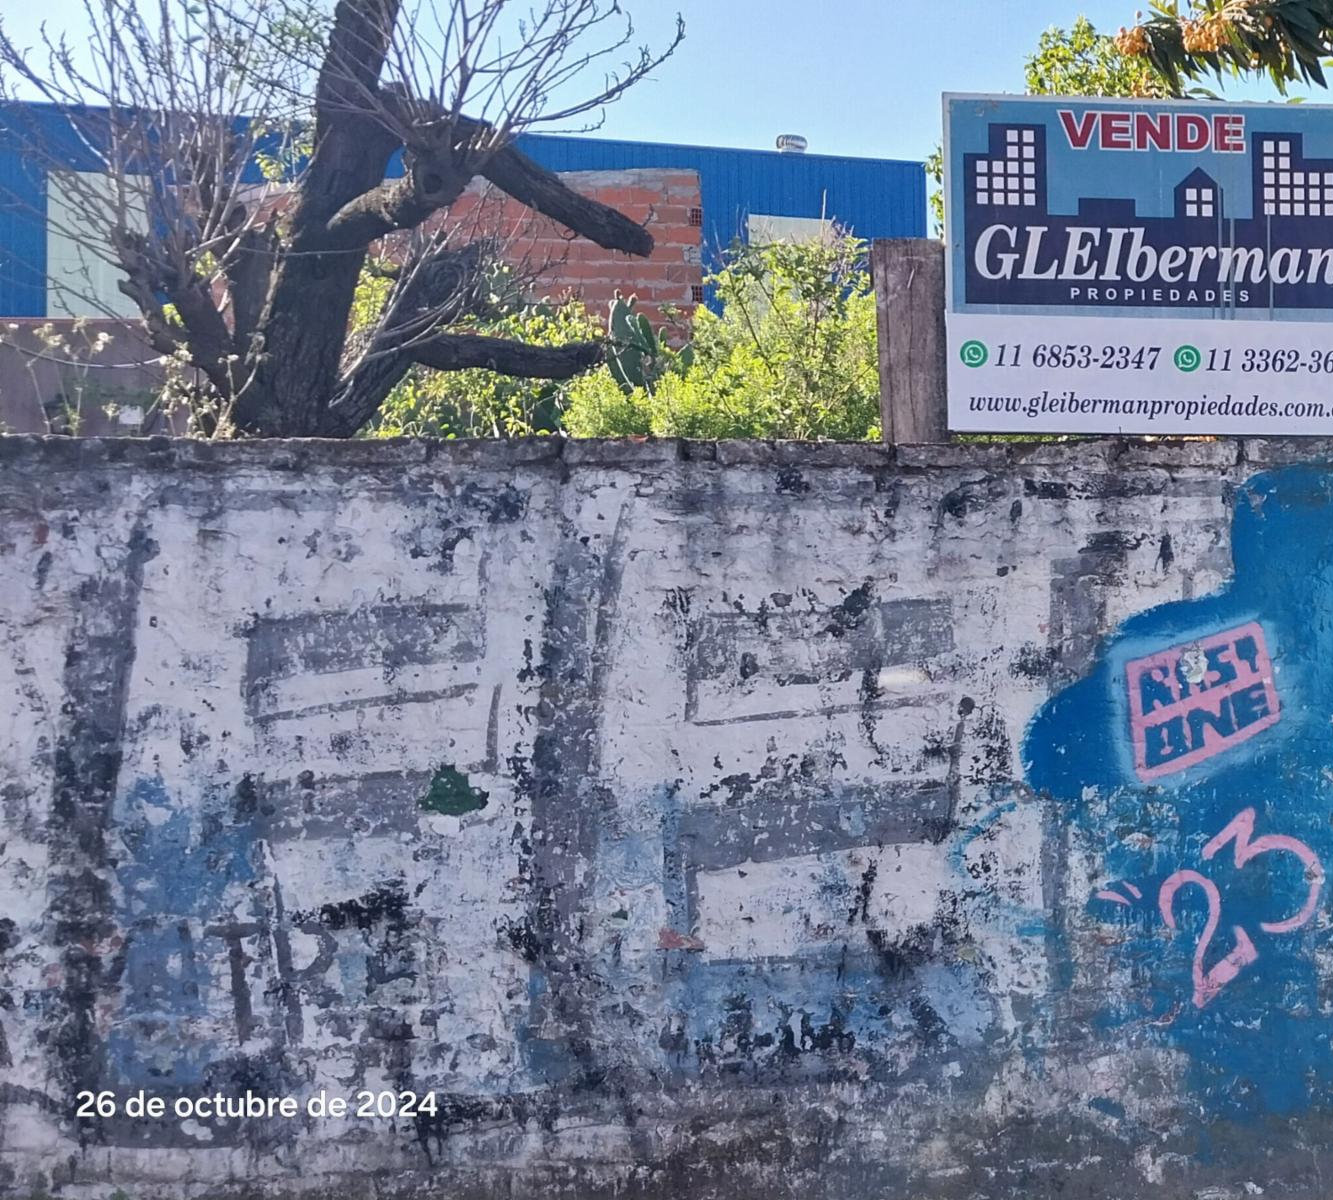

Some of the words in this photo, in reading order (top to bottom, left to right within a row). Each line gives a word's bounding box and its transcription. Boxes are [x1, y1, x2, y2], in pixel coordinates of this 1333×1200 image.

[1057, 110, 1246, 153] VENDE
[1070, 287, 1250, 302] PROPIEDADES
[995, 343, 1021, 367] 11
[1032, 344, 1162, 371] 6853-2347
[1205, 348, 1232, 372] 11
[1144, 682, 1270, 768] ONE
